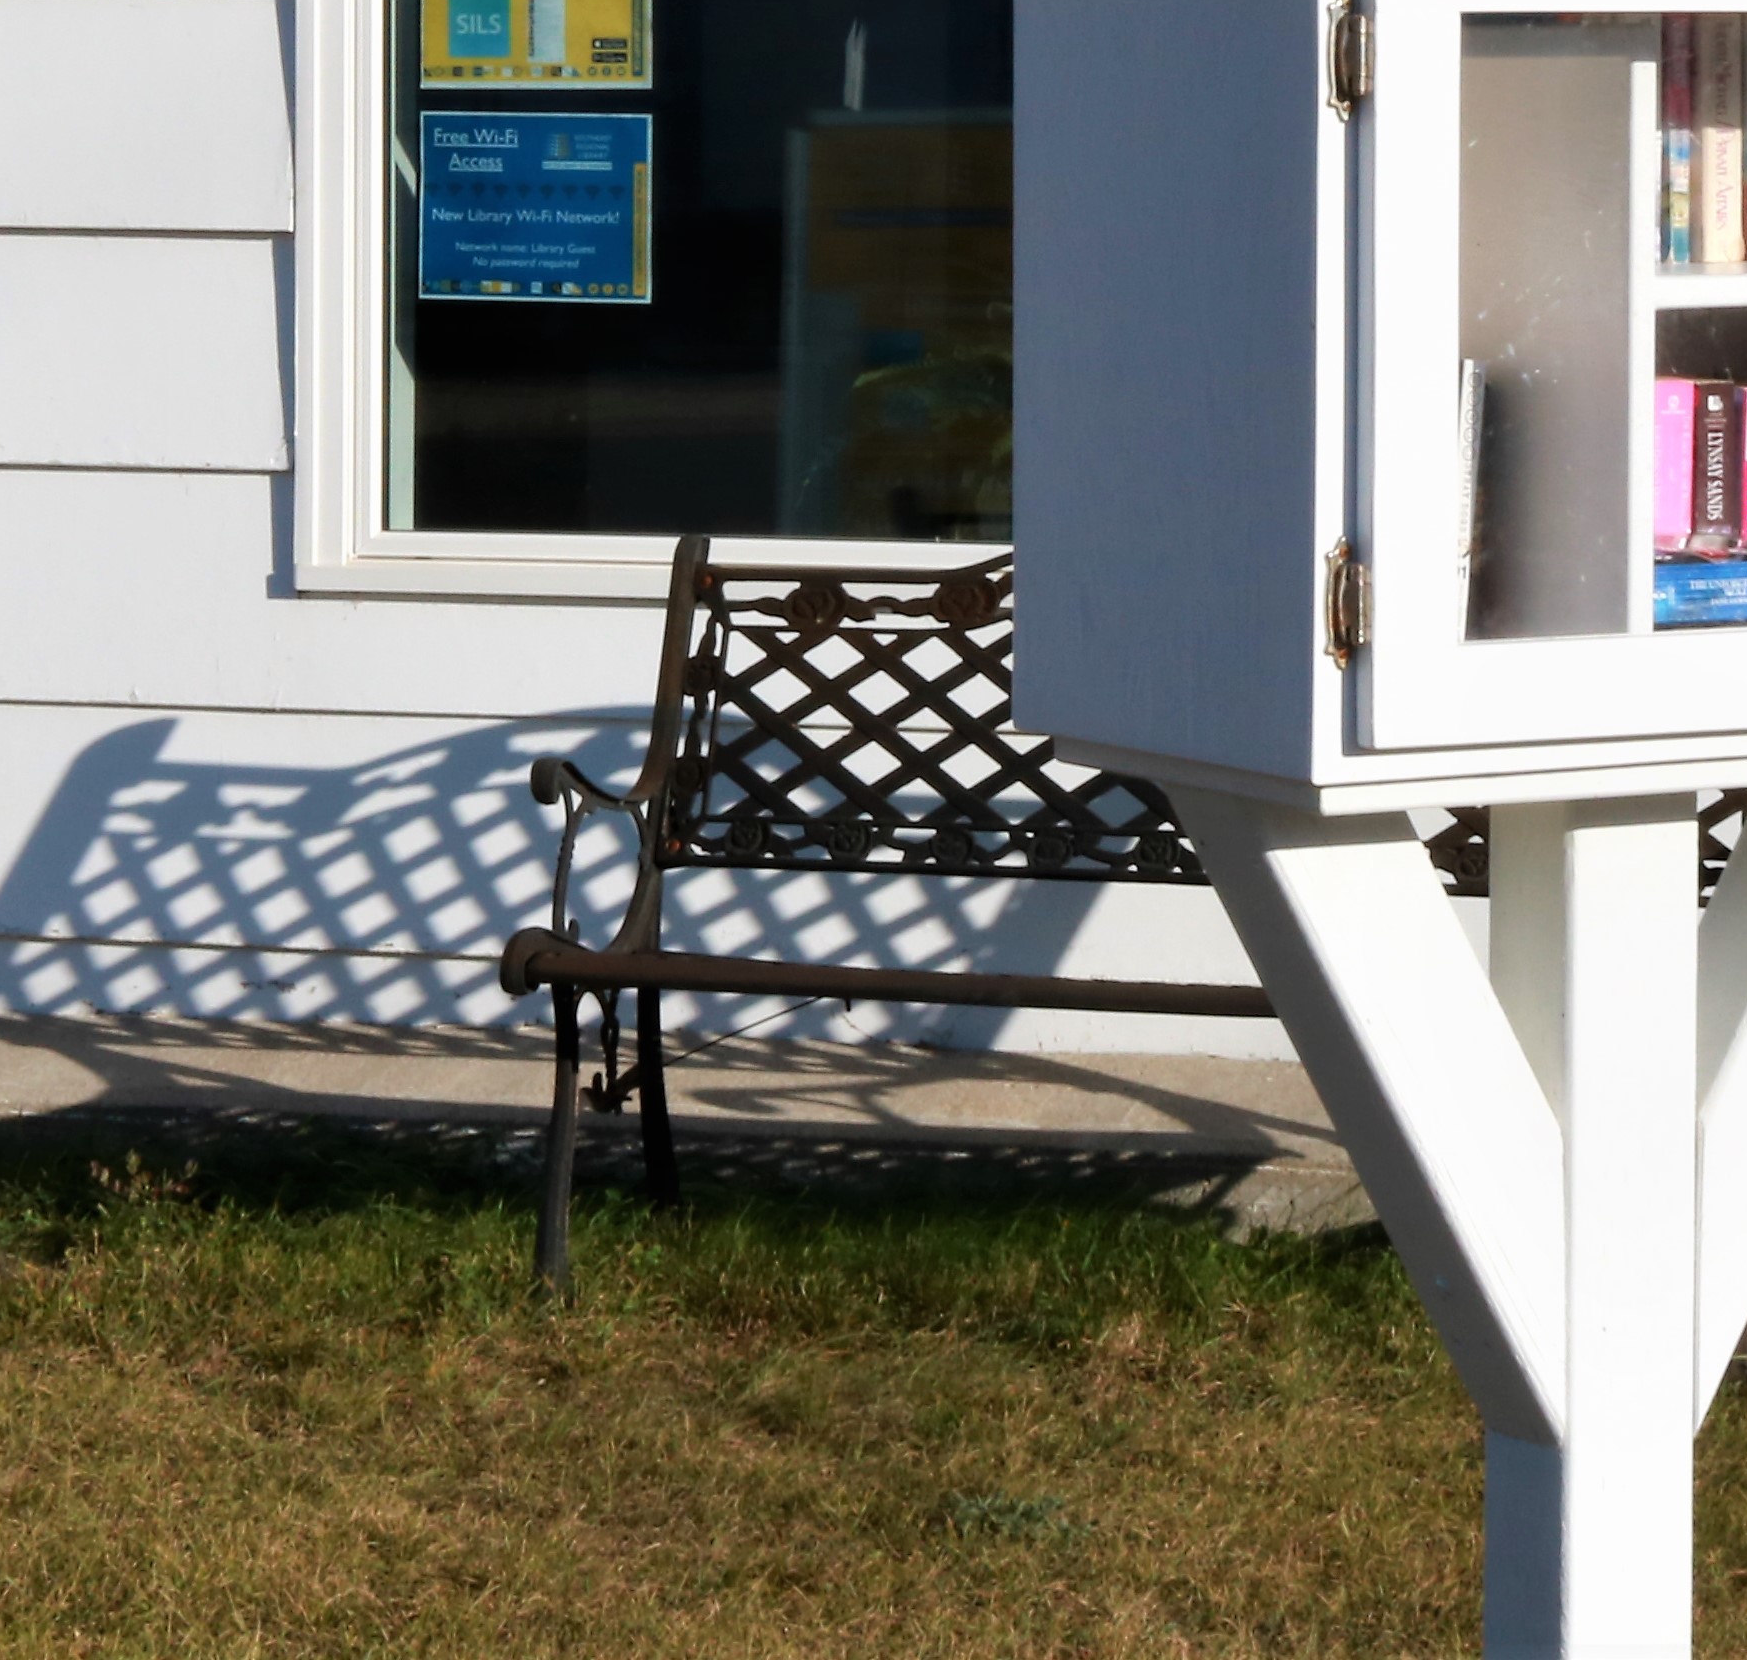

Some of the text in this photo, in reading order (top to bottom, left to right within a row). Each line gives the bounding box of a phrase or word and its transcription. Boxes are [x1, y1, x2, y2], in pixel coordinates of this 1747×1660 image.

[456, 14, 501, 35] SILS
[434, 128, 519, 147] Free Wi-Fi
[449, 153, 503, 171] Access
[432, 208, 619, 225] New Library Wi-Fi Network!
[455, 242, 499, 253] Network
[531, 243, 564, 255] Library
[568, 244, 596, 254] Guest
[1706, 432, 1724, 521] LYNSAY SANDS
